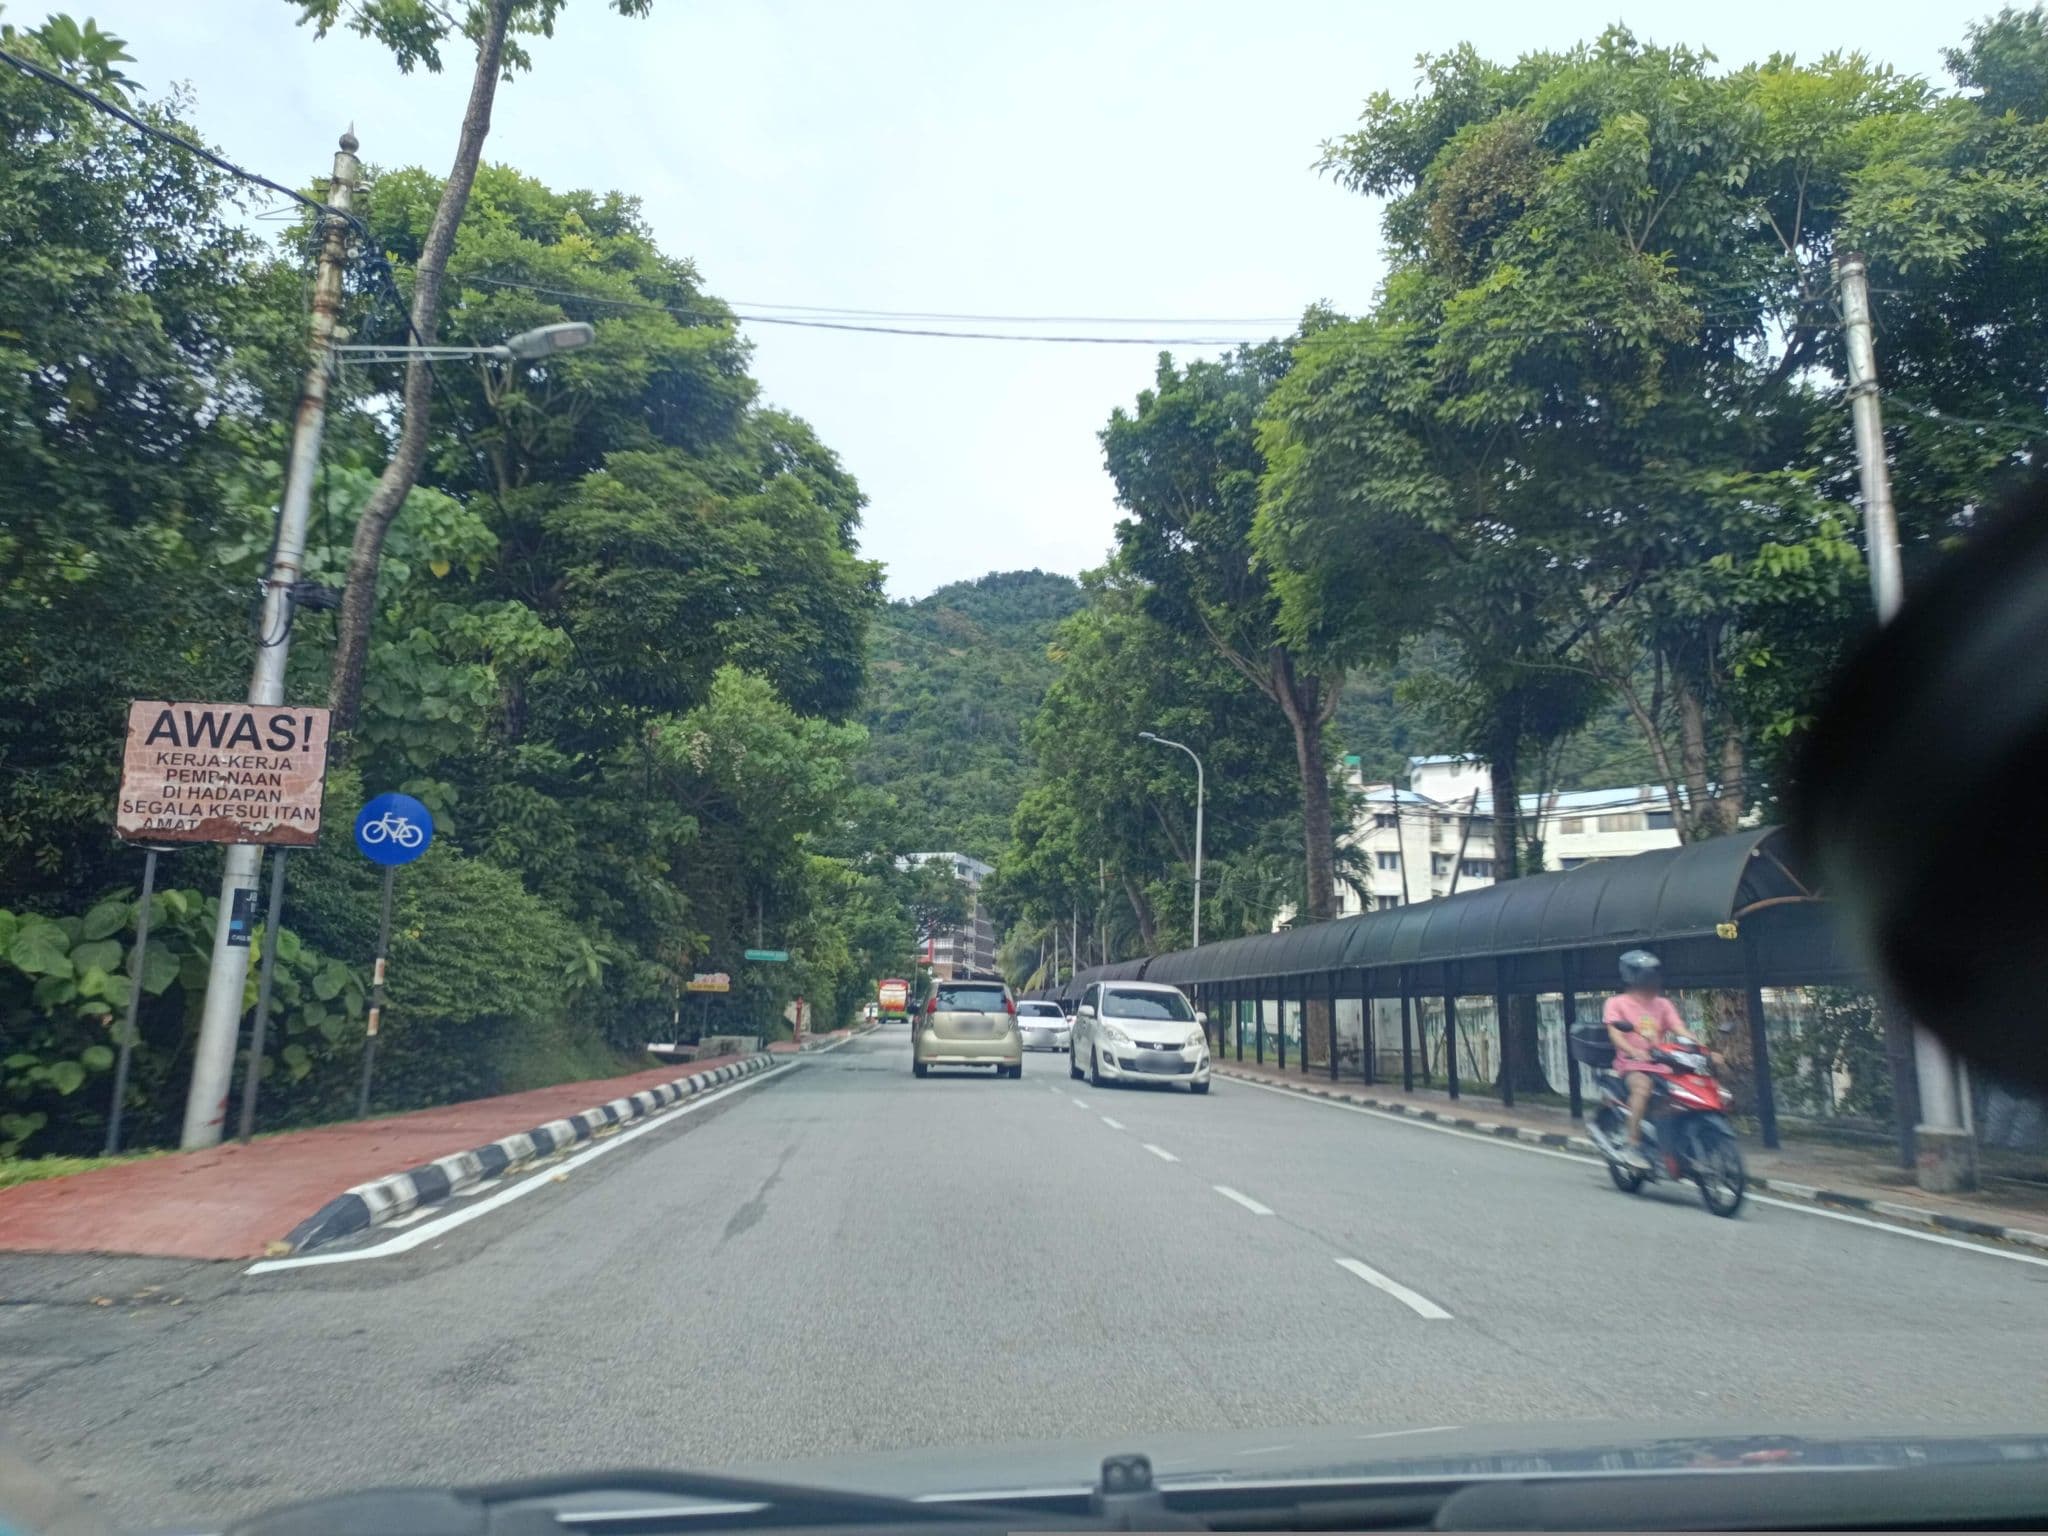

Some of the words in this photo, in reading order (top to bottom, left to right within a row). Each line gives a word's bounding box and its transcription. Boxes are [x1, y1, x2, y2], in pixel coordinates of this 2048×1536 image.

[145, 709, 313, 752] AWAS!
[156, 751, 292, 770] KERJA-KERJA
[166, 769, 282, 787] PEMBNAAN
[163, 785, 181, 799] DI
[188, 787, 282, 803] HADAPAN
[122, 799, 203, 817] SEGALA
[209, 803, 316, 821] KESULITAN
